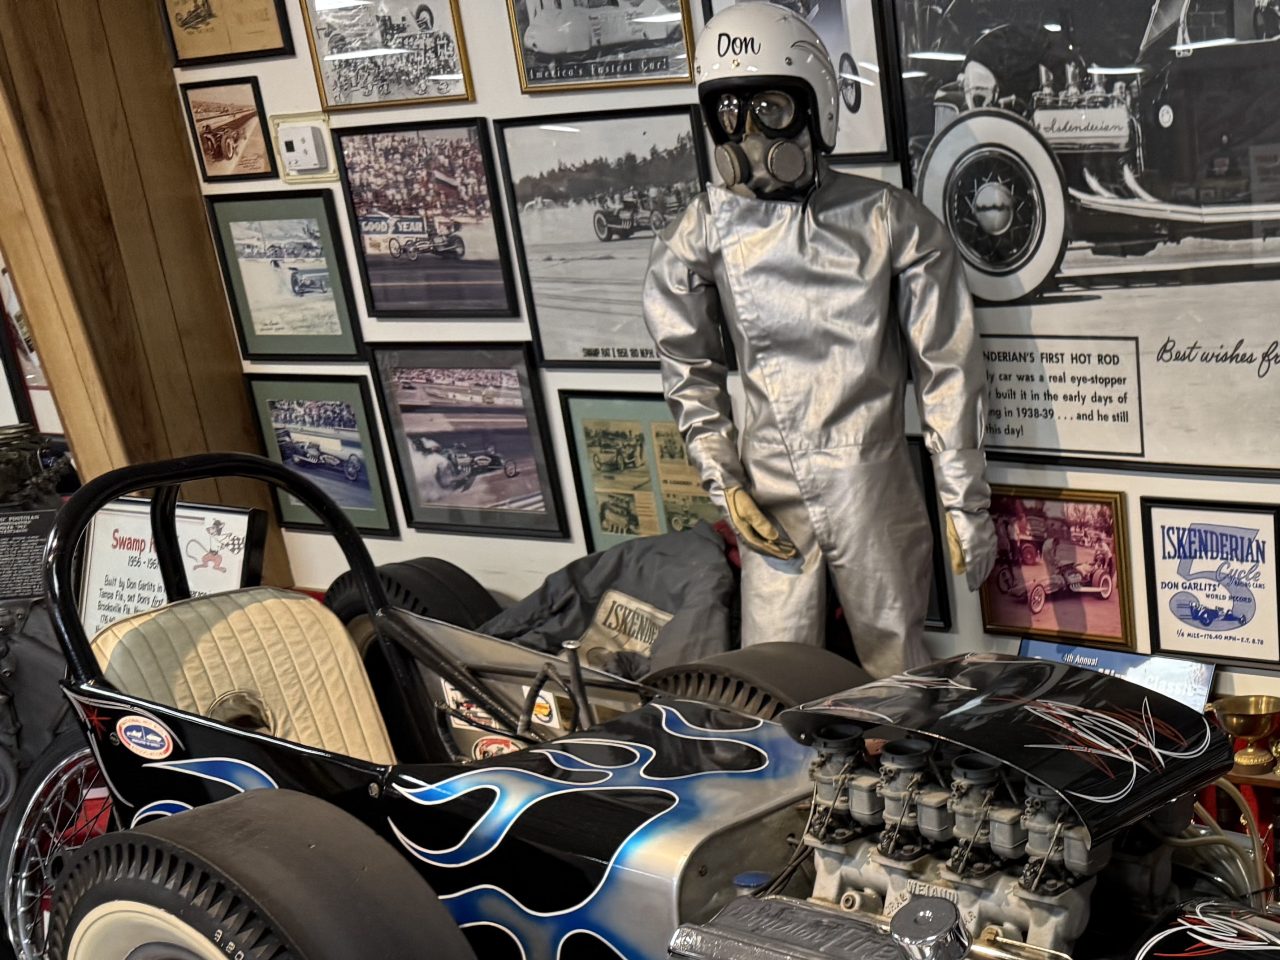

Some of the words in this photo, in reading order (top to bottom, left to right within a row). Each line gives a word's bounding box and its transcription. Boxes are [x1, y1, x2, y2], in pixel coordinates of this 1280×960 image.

[717, 33, 762, 57] Don
[529, 64, 583, 80] America's
[591, 62, 633, 76] Fastest
[361, 221, 387, 232] GOOD
[397, 221, 423, 232] YEAR
[1156, 336, 1201, 363] Best
[1200, 338, 1257, 364] wishes
[1040, 352, 1064, 364] FIRST
[1071, 353, 1092, 364] HOT
[1098, 354, 1120, 365] ROD
[999, 372, 1012, 382] car
[1016, 373, 1035, 382] was
[1039, 374, 1044, 382] a
[1049, 372, 1066, 383] real
[1070, 373, 1127, 387] eye-stopper
[995, 388, 1016, 399] built
[1020, 389, 1027, 400] it
[1030, 389, 1039, 400] in
[1044, 390, 1058, 401] the
[1063, 391, 1086, 405] early
[1091, 392, 1113, 406] days
[1117, 392, 1128, 403] of
[1004, 407, 1013, 417] in
[1016, 408, 1054, 419] 1938-39
[1076, 410, 1094, 421] and
[1097, 409, 1109, 422] he
[1112, 411, 1129, 422] still
[1004, 425, 1024, 438] day!
[111, 528, 146, 555] Swamp
[1160, 525, 1266, 564] ISKENDERIAN
[1216, 561, 1262, 584] Cycle
[104, 574, 117, 588] Built
[118, 578, 126, 592] by
[126, 578, 137, 589] Don
[137, 579, 156, 592] Garlits
[156, 581, 163, 593] in
[1160, 581, 1179, 590] DON
[1181, 582, 1220, 592] GARLITS'
[1229, 595, 1252, 603] RECORD
[1176, 629, 1185, 637] 1/4
[1063, 652, 1074, 663] 4th
[1074, 654, 1098, 666] Annual
